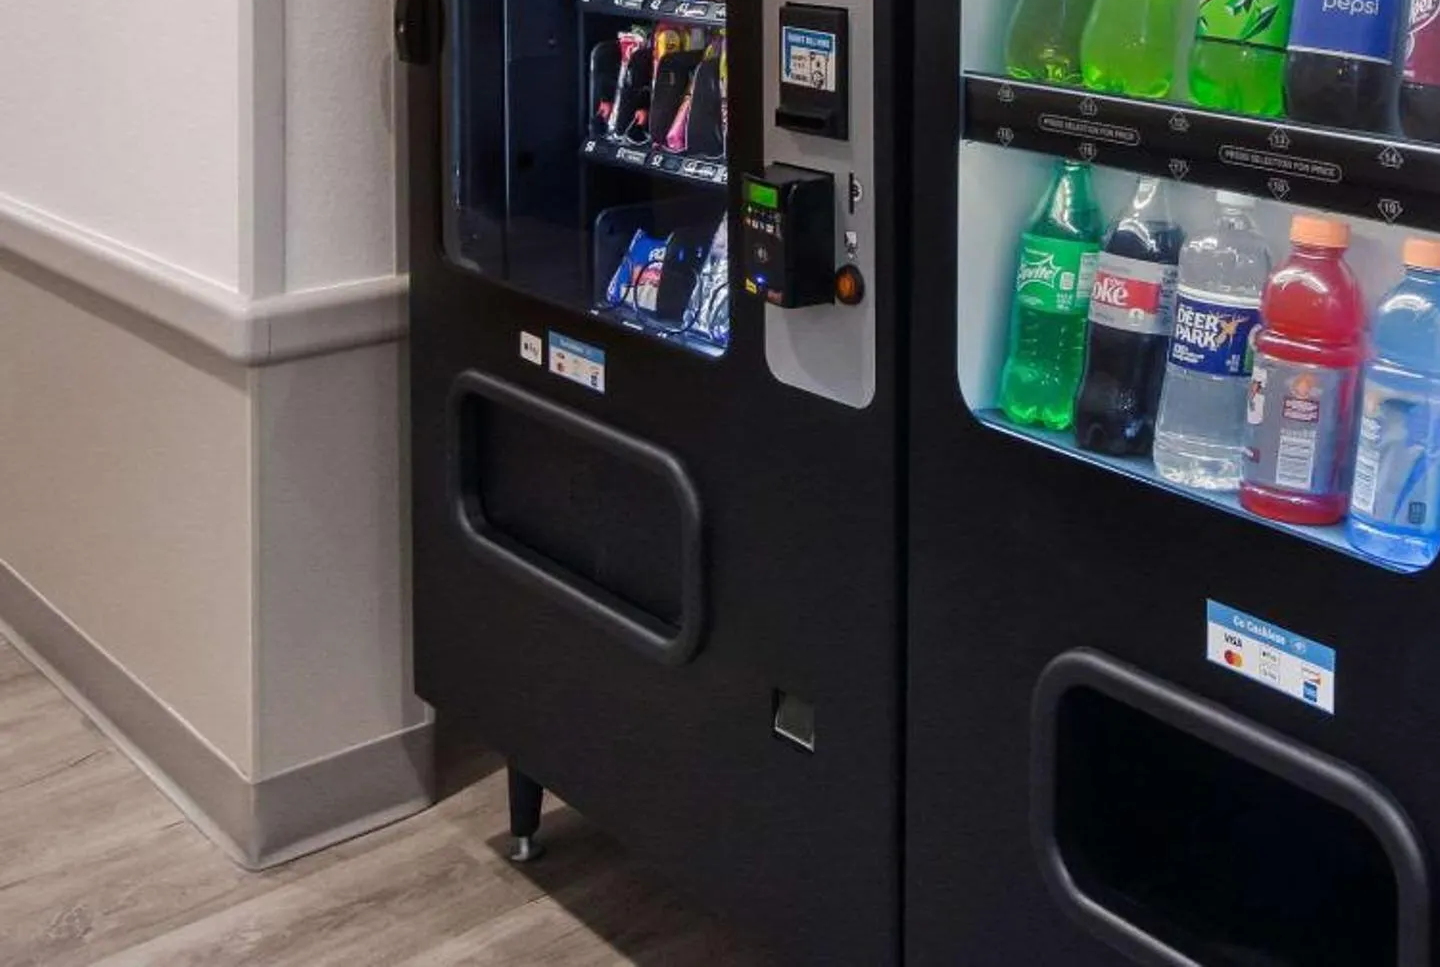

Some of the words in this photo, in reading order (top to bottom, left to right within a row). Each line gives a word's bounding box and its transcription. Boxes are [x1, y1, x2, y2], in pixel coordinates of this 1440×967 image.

[1092, 277, 1129, 306] oke
[1178, 307, 1218, 332] DEER
[1175, 324, 1218, 352] PARK
